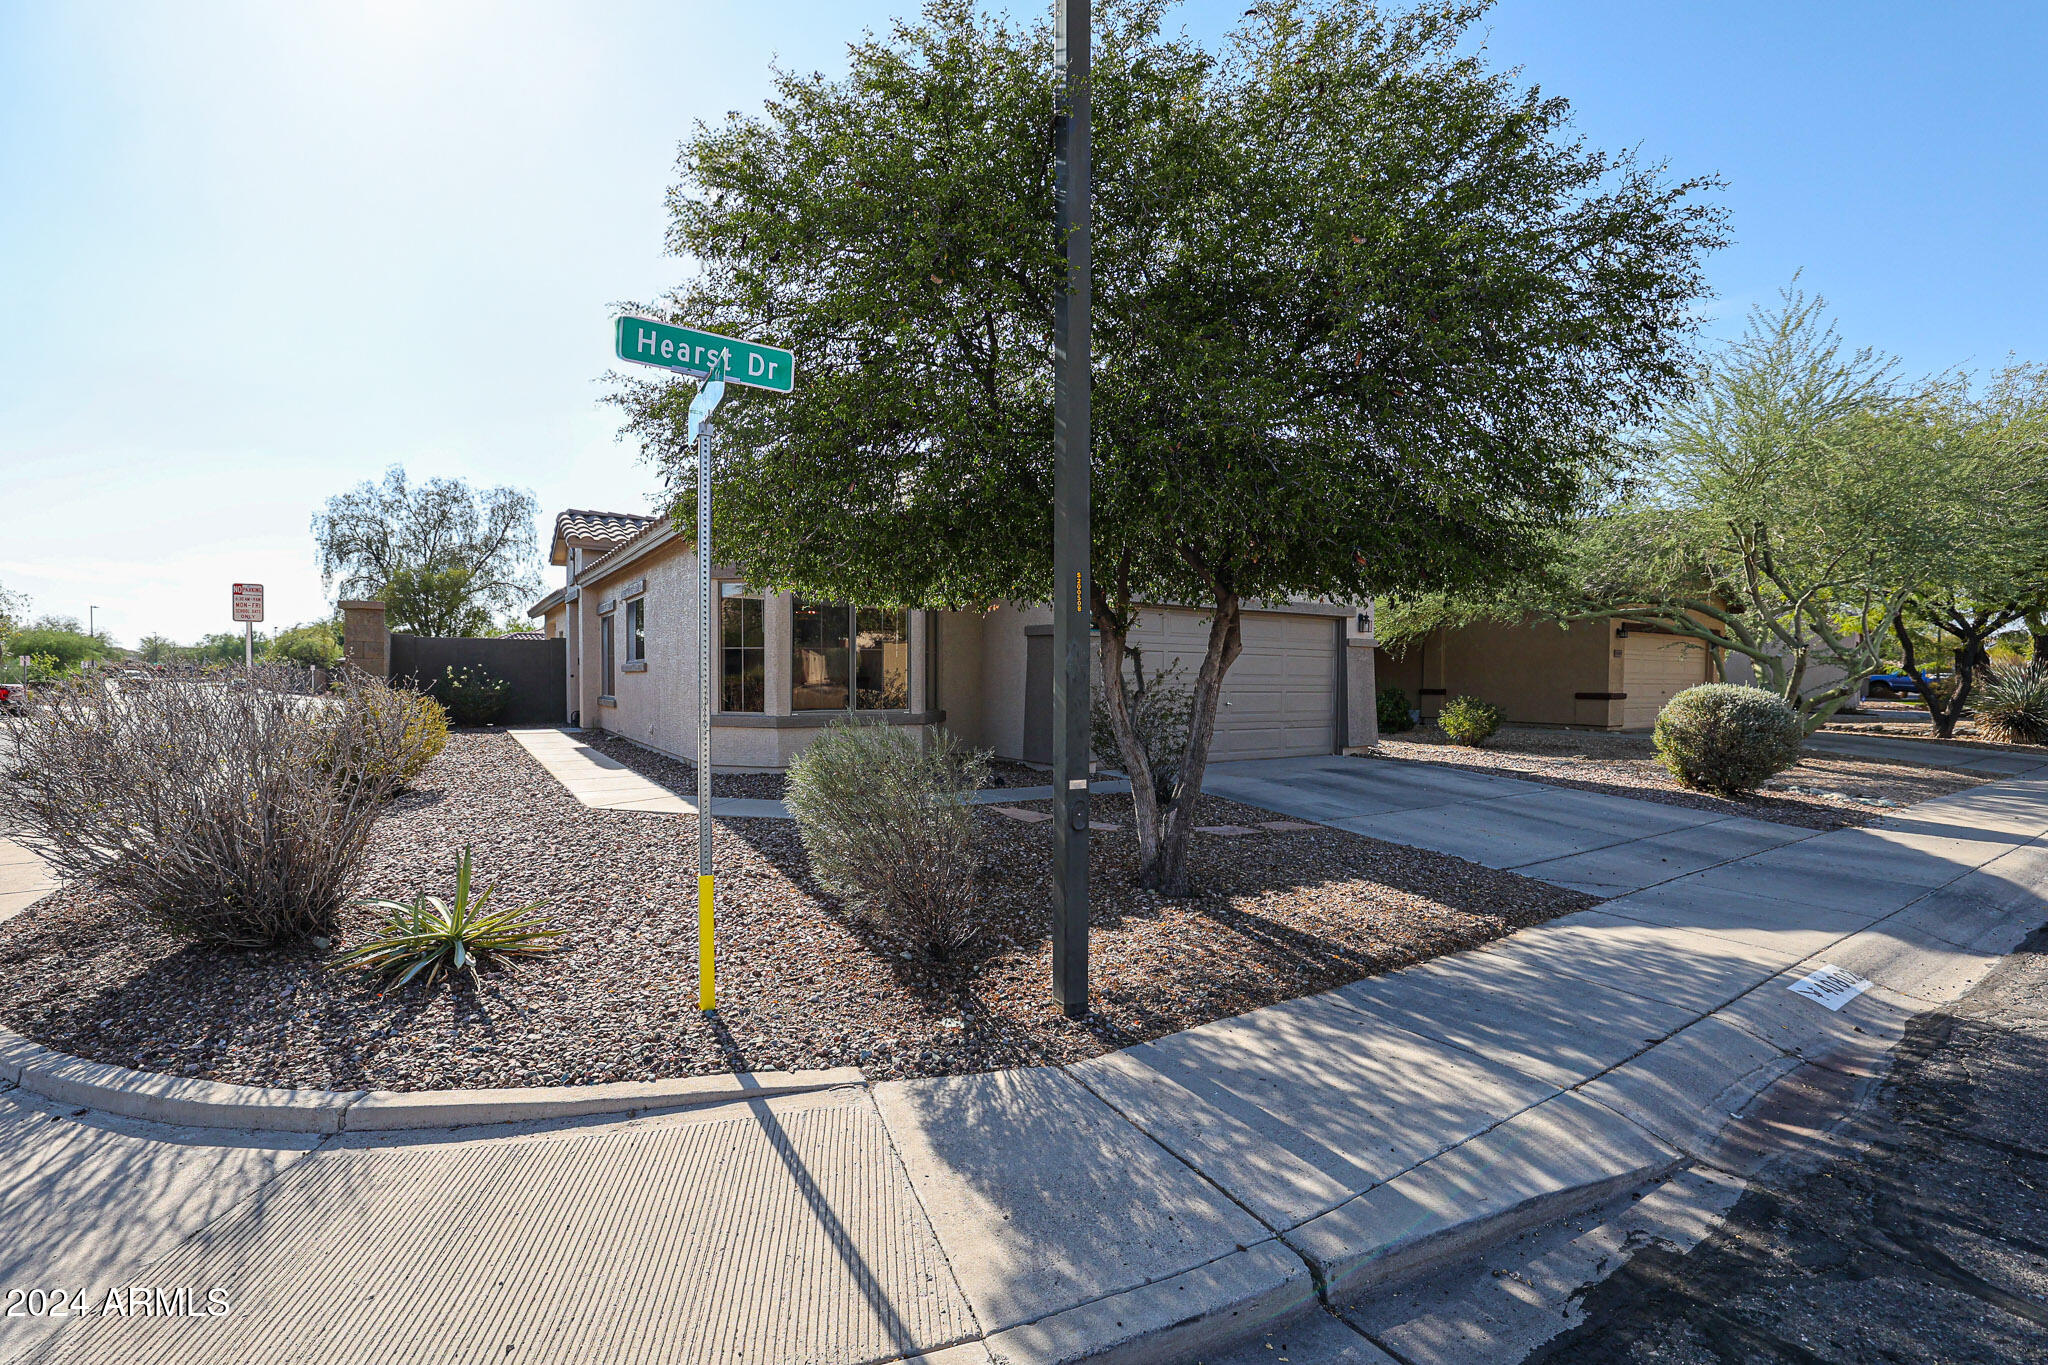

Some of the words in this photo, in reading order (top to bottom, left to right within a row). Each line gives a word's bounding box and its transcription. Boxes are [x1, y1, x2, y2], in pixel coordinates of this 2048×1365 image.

[637, 328, 732, 371] Hearst
[748, 352, 778, 380] Dr
[234, 585, 242, 594] NO
